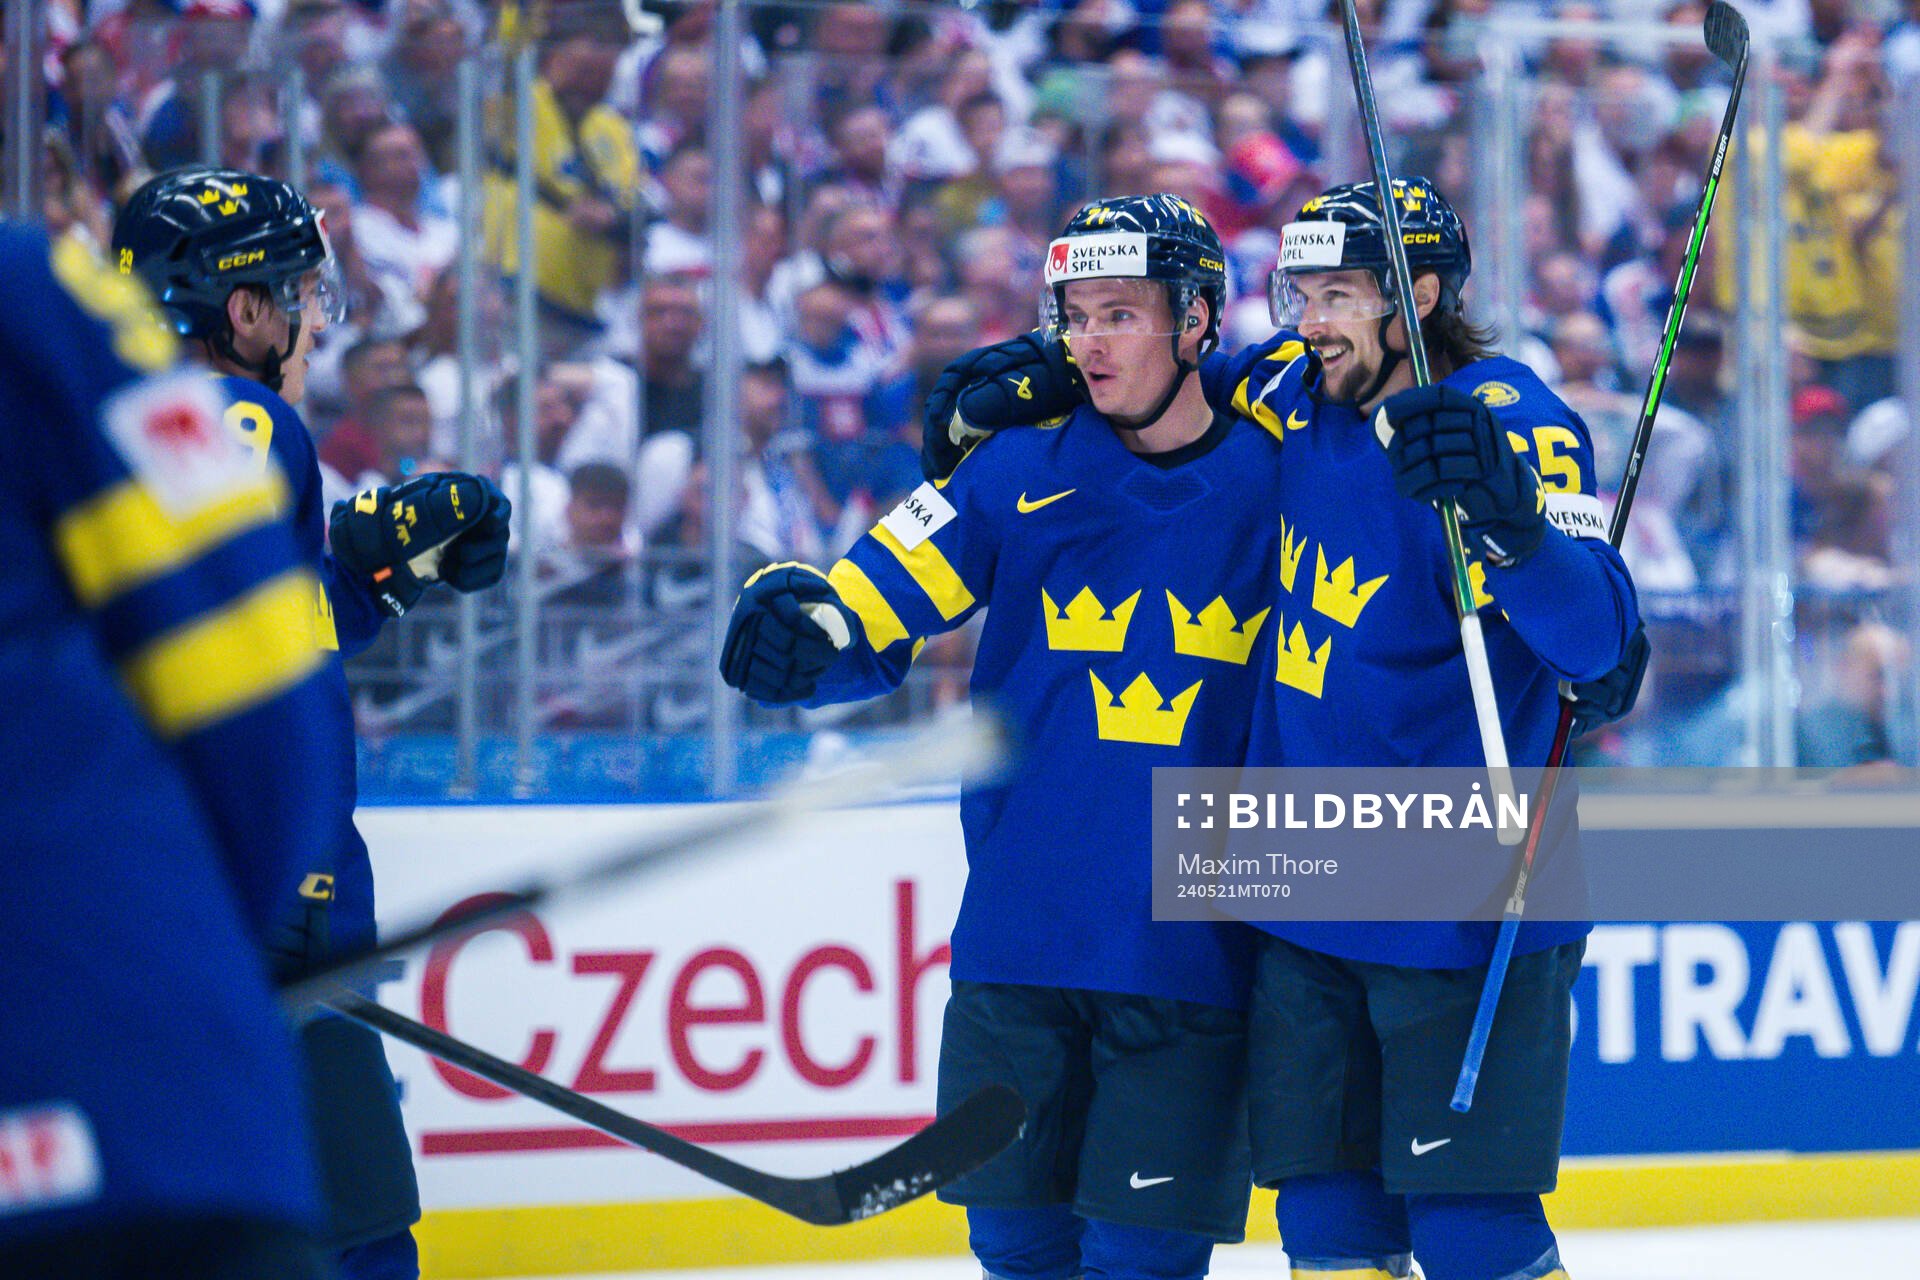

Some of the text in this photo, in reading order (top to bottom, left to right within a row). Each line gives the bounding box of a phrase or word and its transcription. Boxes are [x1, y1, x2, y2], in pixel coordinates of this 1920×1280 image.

[1713, 134, 1728, 176] BAUER
[1285, 234, 1336, 246] SVENSKA
[1403, 233, 1441, 244] CCM
[119, 248, 134, 275] 29
[218, 249, 266, 271] CCM
[1072, 244, 1139, 259] SVENSKA
[1283, 248, 1304, 261] SPEL
[1072, 261, 1105, 273] SPEL
[1199, 257, 1223, 272] CCM
[1506, 426, 1582, 494] 5
[904, 498, 933, 527] SKA
[298, 872, 335, 901] C
[420, 880, 951, 1101] Czech
[1569, 922, 1920, 1064] TRAV
